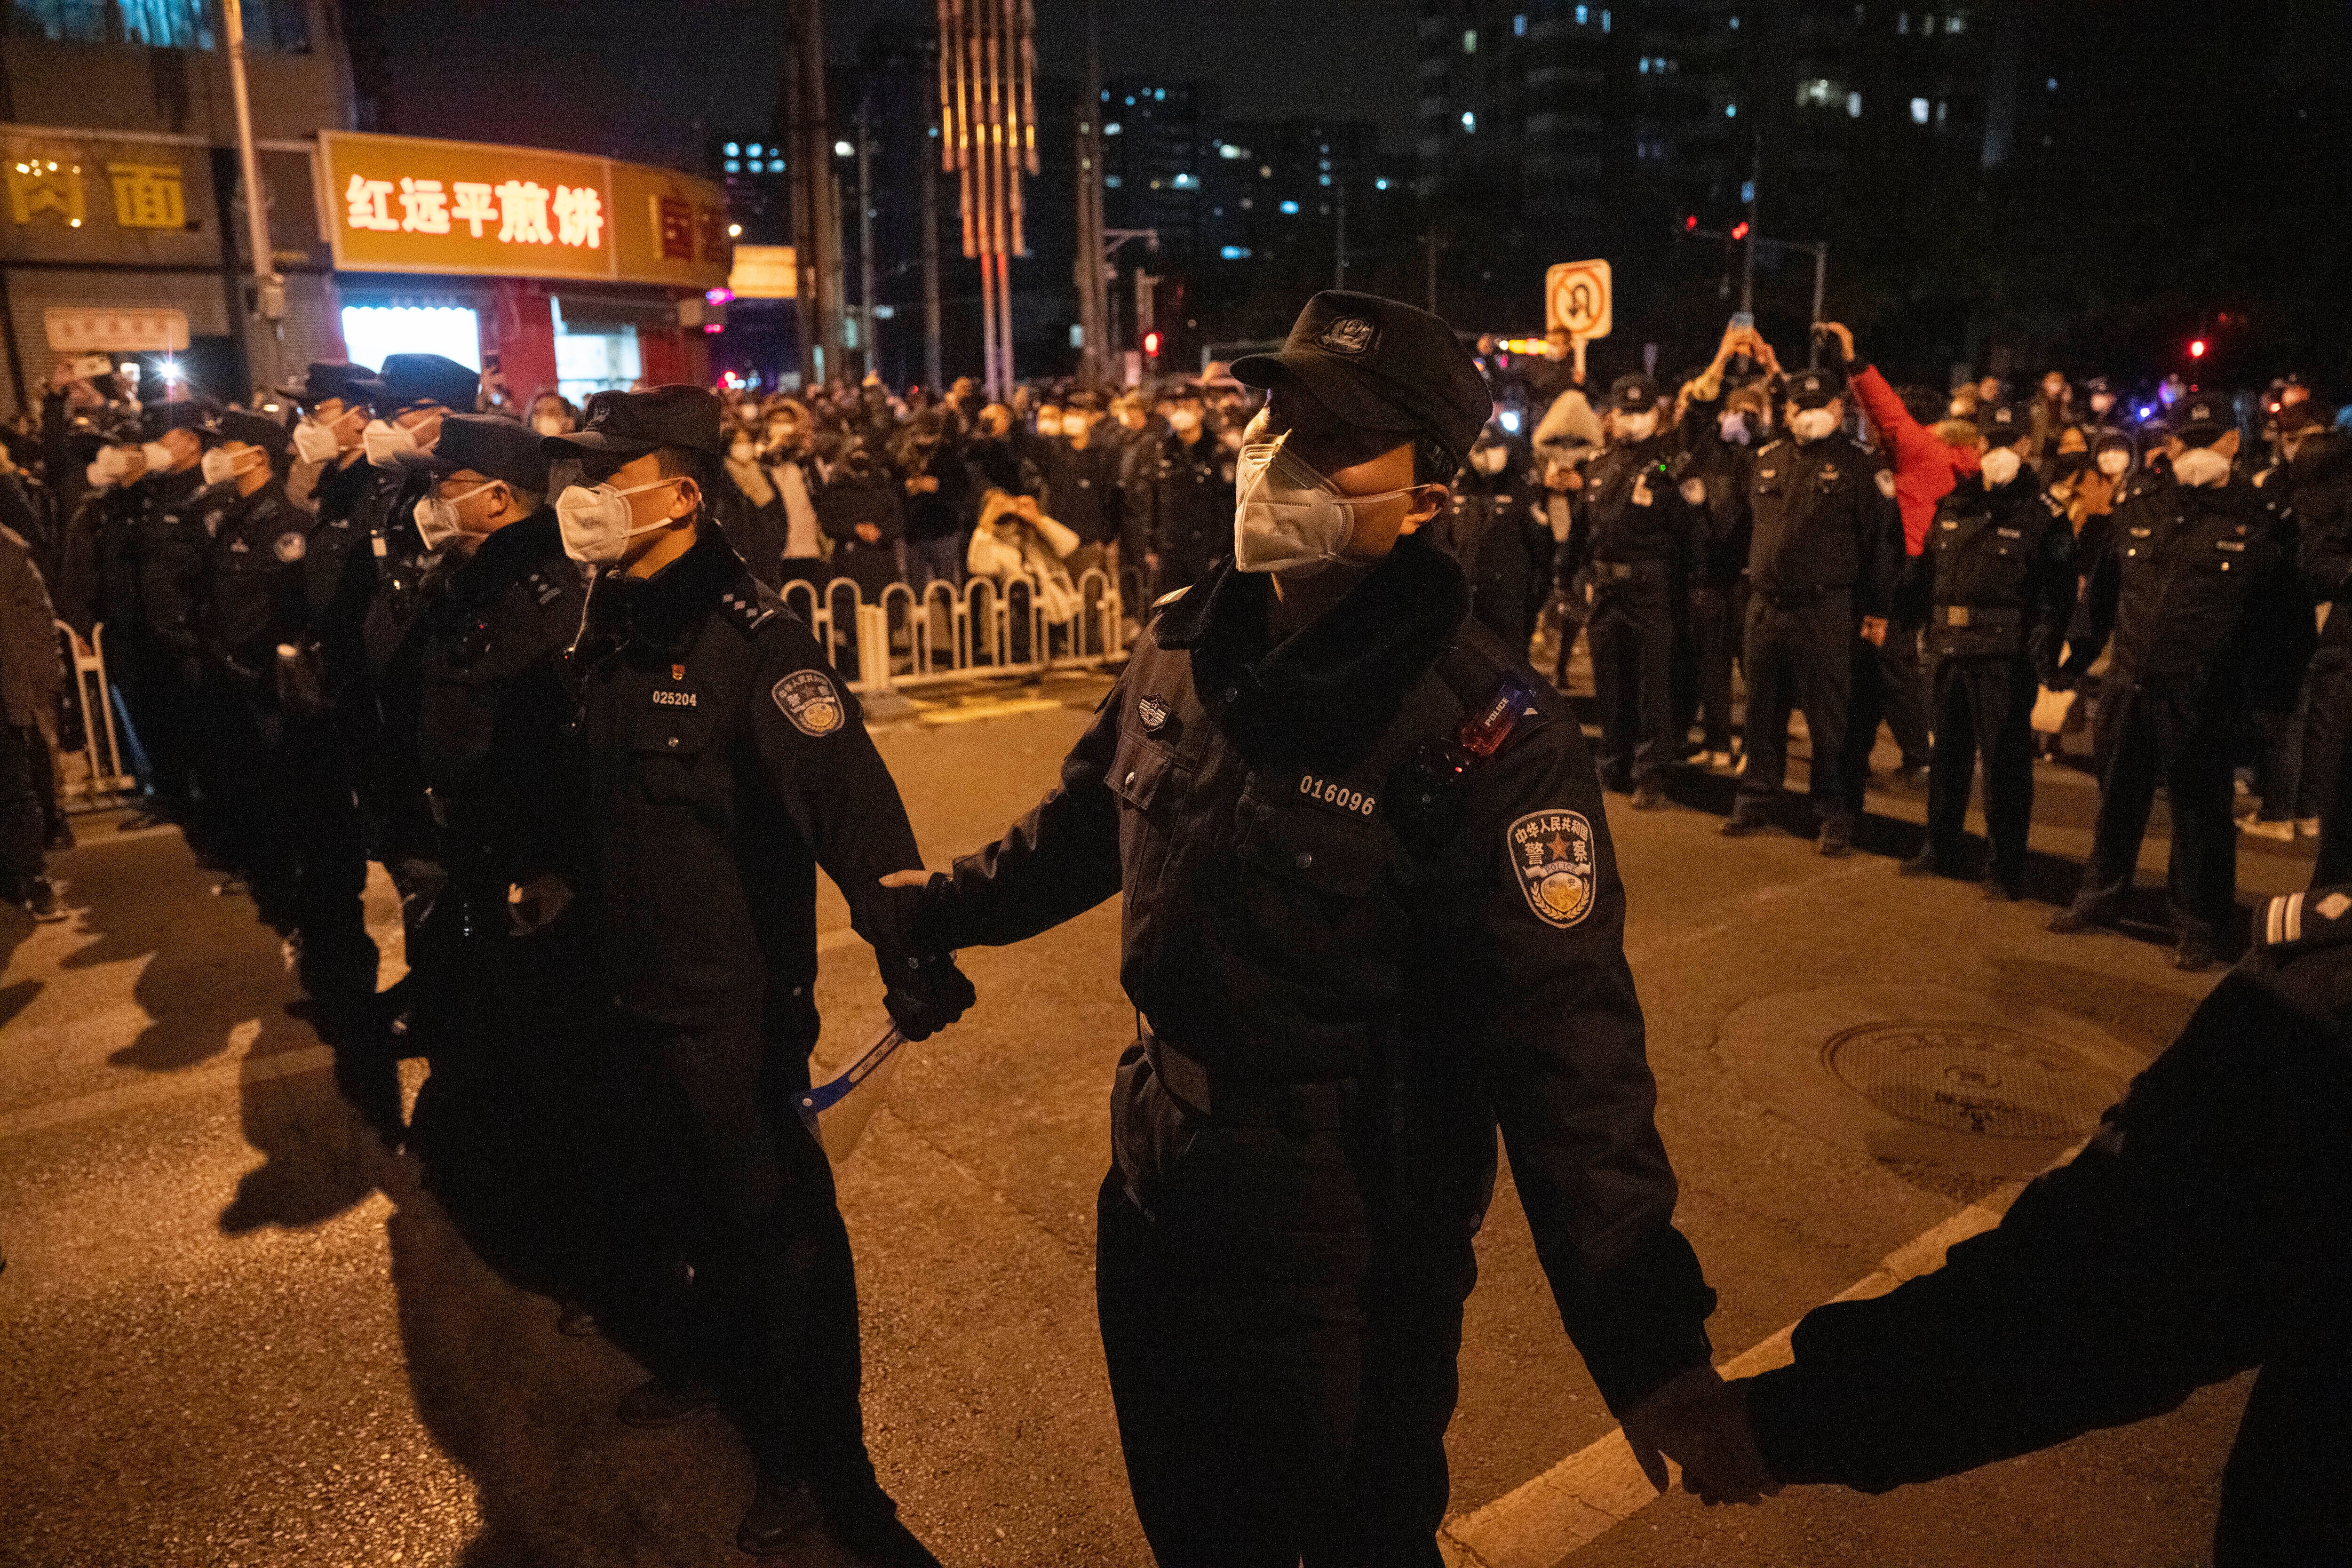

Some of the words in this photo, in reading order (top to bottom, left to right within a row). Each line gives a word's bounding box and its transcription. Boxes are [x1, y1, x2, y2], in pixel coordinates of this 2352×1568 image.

[346, 173, 604, 249] 红远平煎饼
[652, 690, 697, 707] 025204
[1485, 697, 1509, 727] POLICE
[1300, 775, 1375, 815] 016096
[1515, 816, 1588, 844] 中华人民共和国
[1544, 862, 1577, 873] POLICE
